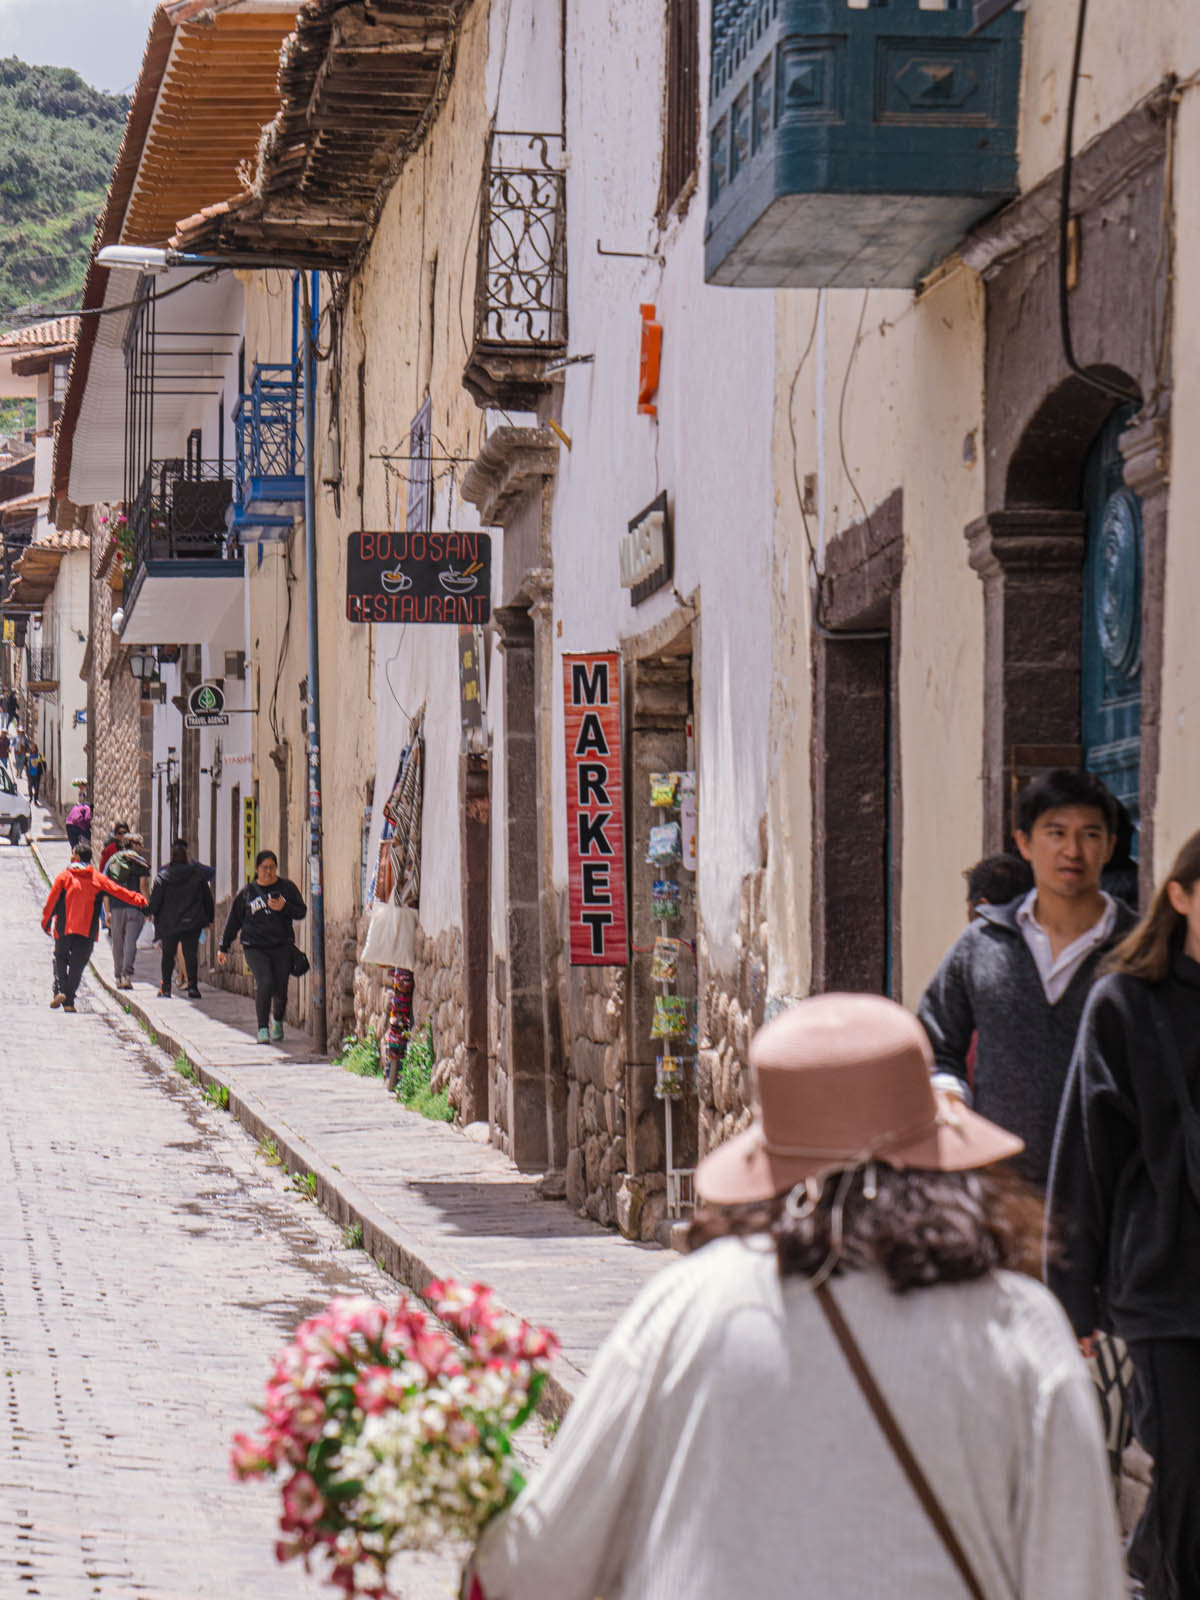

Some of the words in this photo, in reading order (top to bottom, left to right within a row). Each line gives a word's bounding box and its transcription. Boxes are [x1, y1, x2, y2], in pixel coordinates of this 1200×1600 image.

[360, 533, 479, 561] BOJOSAN
[348, 594, 487, 623] RESTAURANT
[188, 716, 208, 726] TRAVEL
[208, 715, 228, 725] AGENCY
[571, 661, 614, 957] MARKET
